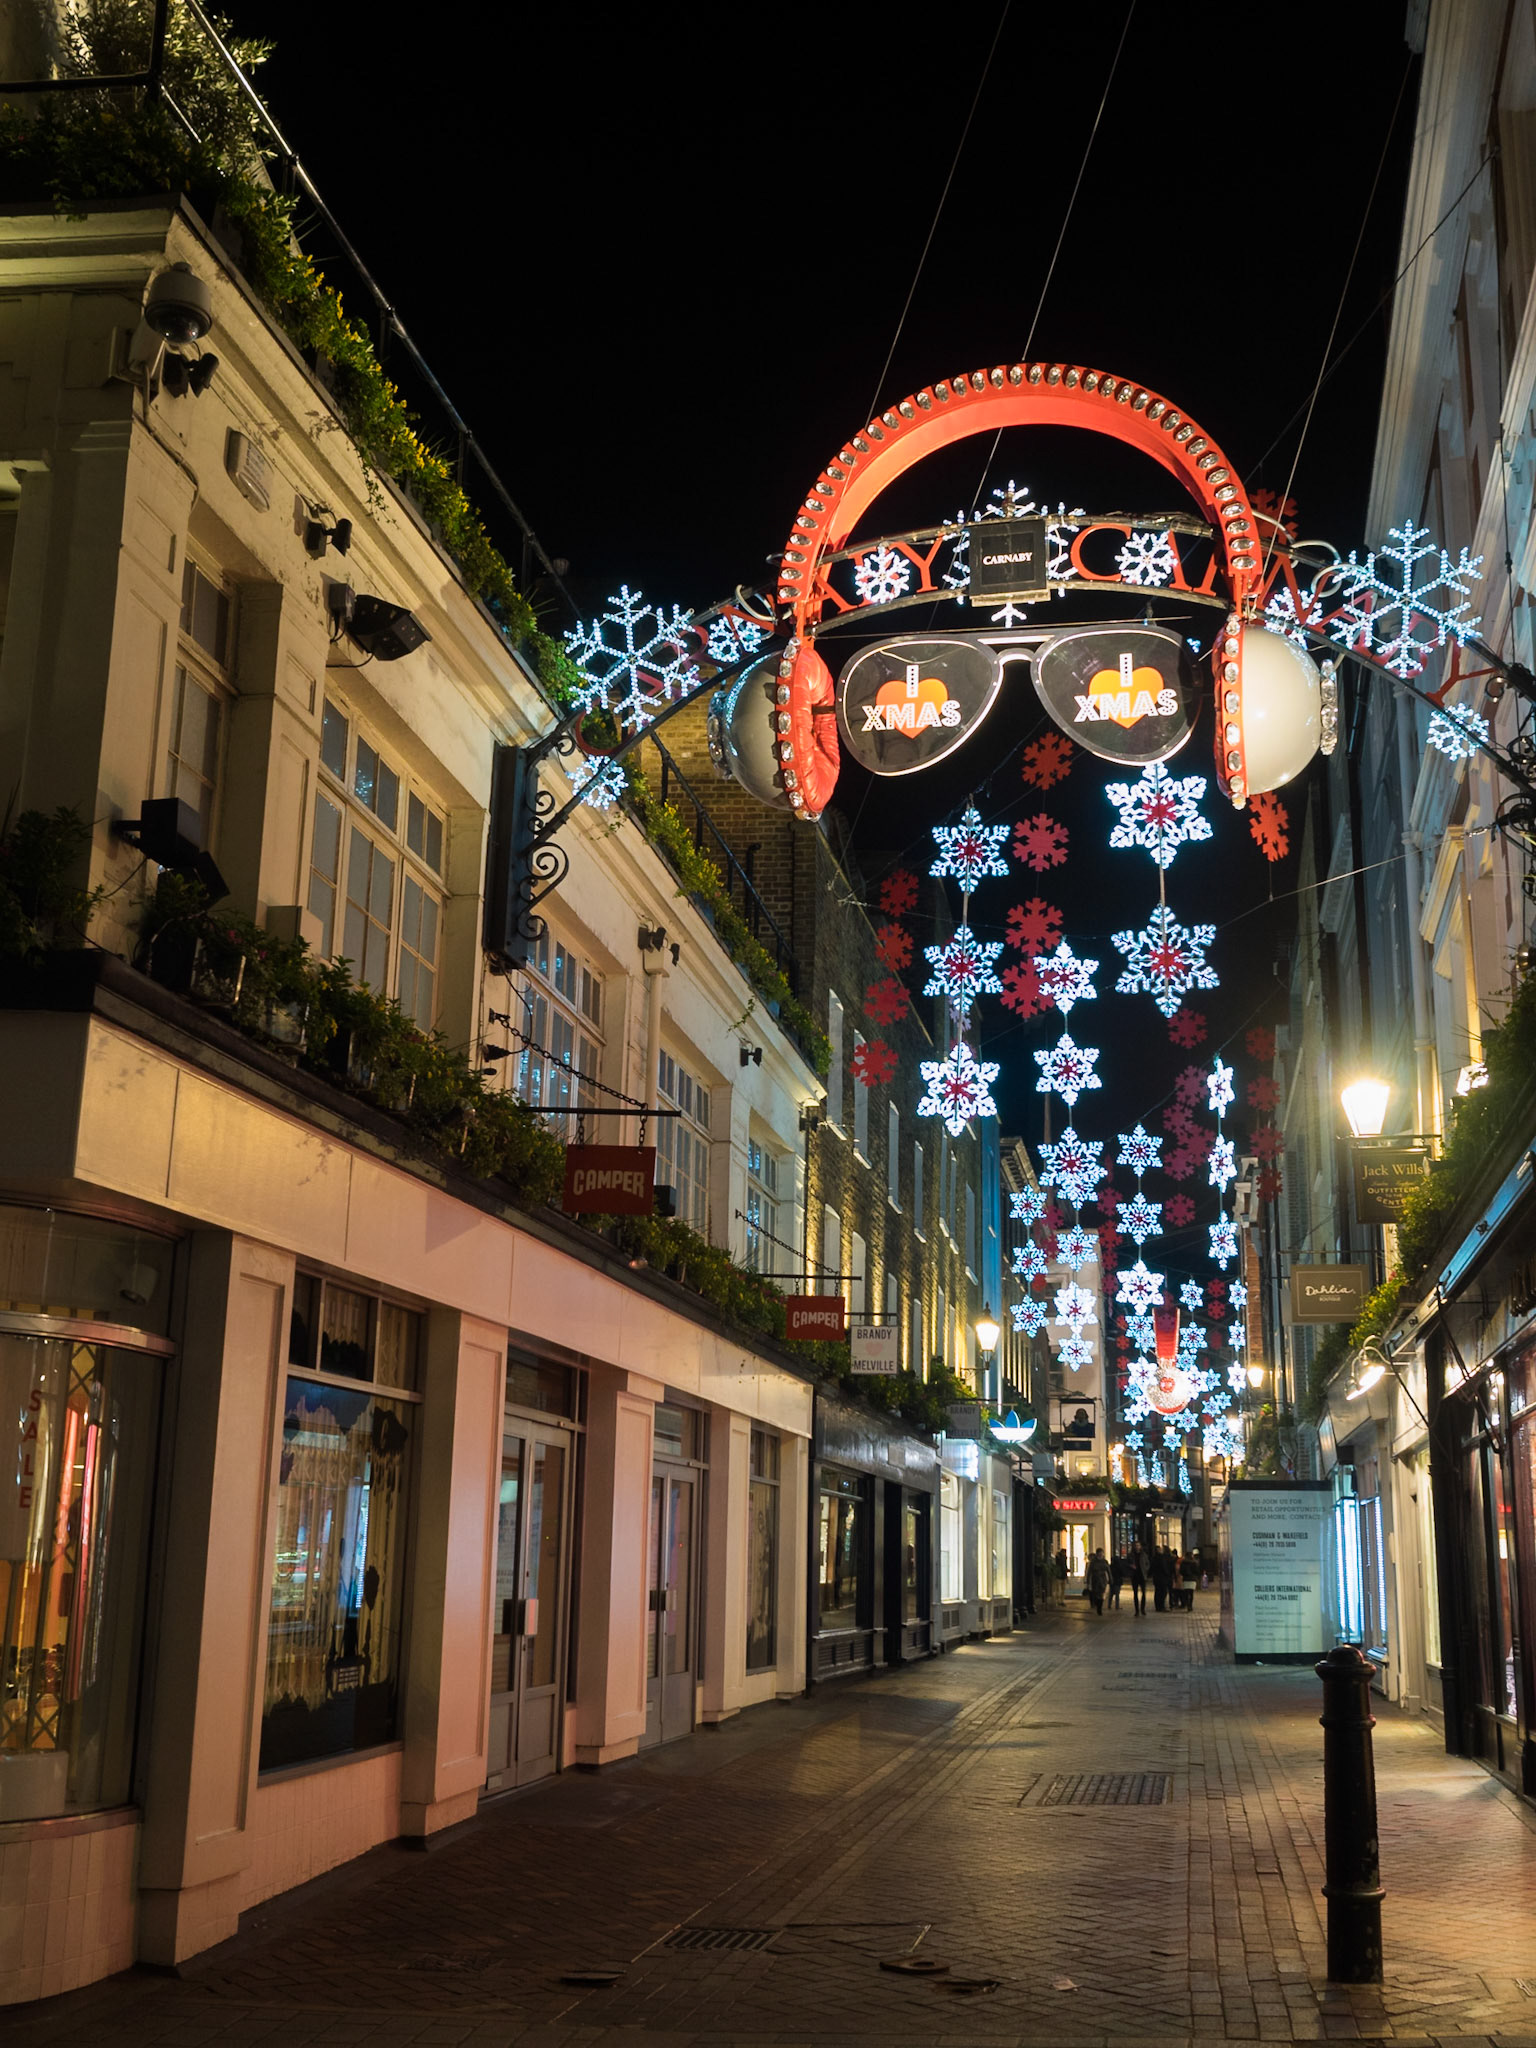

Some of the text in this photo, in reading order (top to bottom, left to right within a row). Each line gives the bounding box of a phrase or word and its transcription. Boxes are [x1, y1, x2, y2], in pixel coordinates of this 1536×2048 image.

[983, 552, 1033, 566] CARNABY
[1119, 652, 1133, 687] I
[906, 665, 920, 698] I
[1073, 688, 1179, 723] XMAS
[861, 699, 962, 732] XMAS
[1362, 1163, 1424, 1180] Jack Wills
[573, 1168, 646, 1199] CAMPER
[1304, 1284, 1355, 1296] Dahlia
[792, 1311, 839, 1330] CAMPER
[857, 1328, 892, 1340] BRANDY
[853, 1360, 894, 1372] MELVILLE
[950, 1406, 976, 1414] BRANDY
[1062, 1500, 1097, 1511] SIXTY
